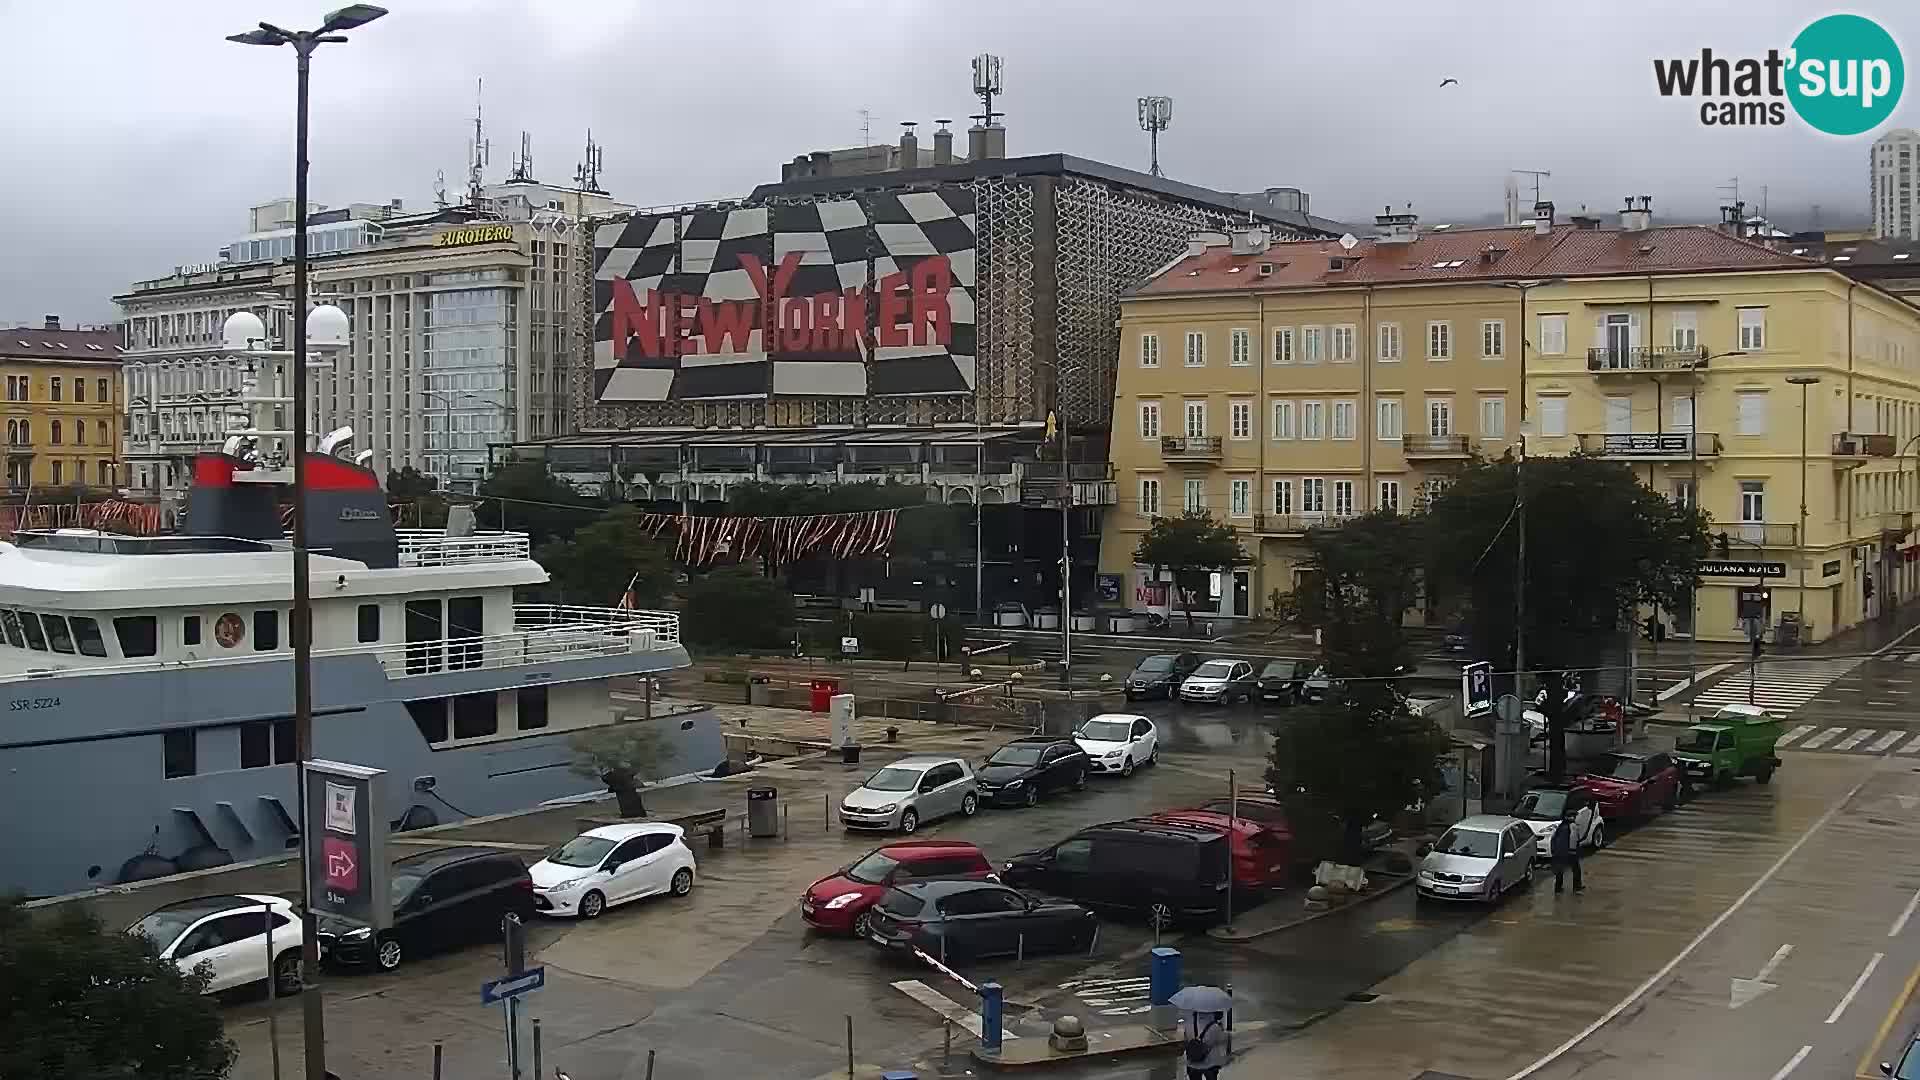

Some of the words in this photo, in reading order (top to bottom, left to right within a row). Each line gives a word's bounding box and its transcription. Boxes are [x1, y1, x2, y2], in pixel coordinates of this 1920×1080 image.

[1699, 564, 1745, 574] JULIANA
[1748, 565, 1781, 575] NAILS
[1473, 669, 1485, 693] P
[9, 699, 30, 711] SSR
[327, 890, 333, 903] 5
